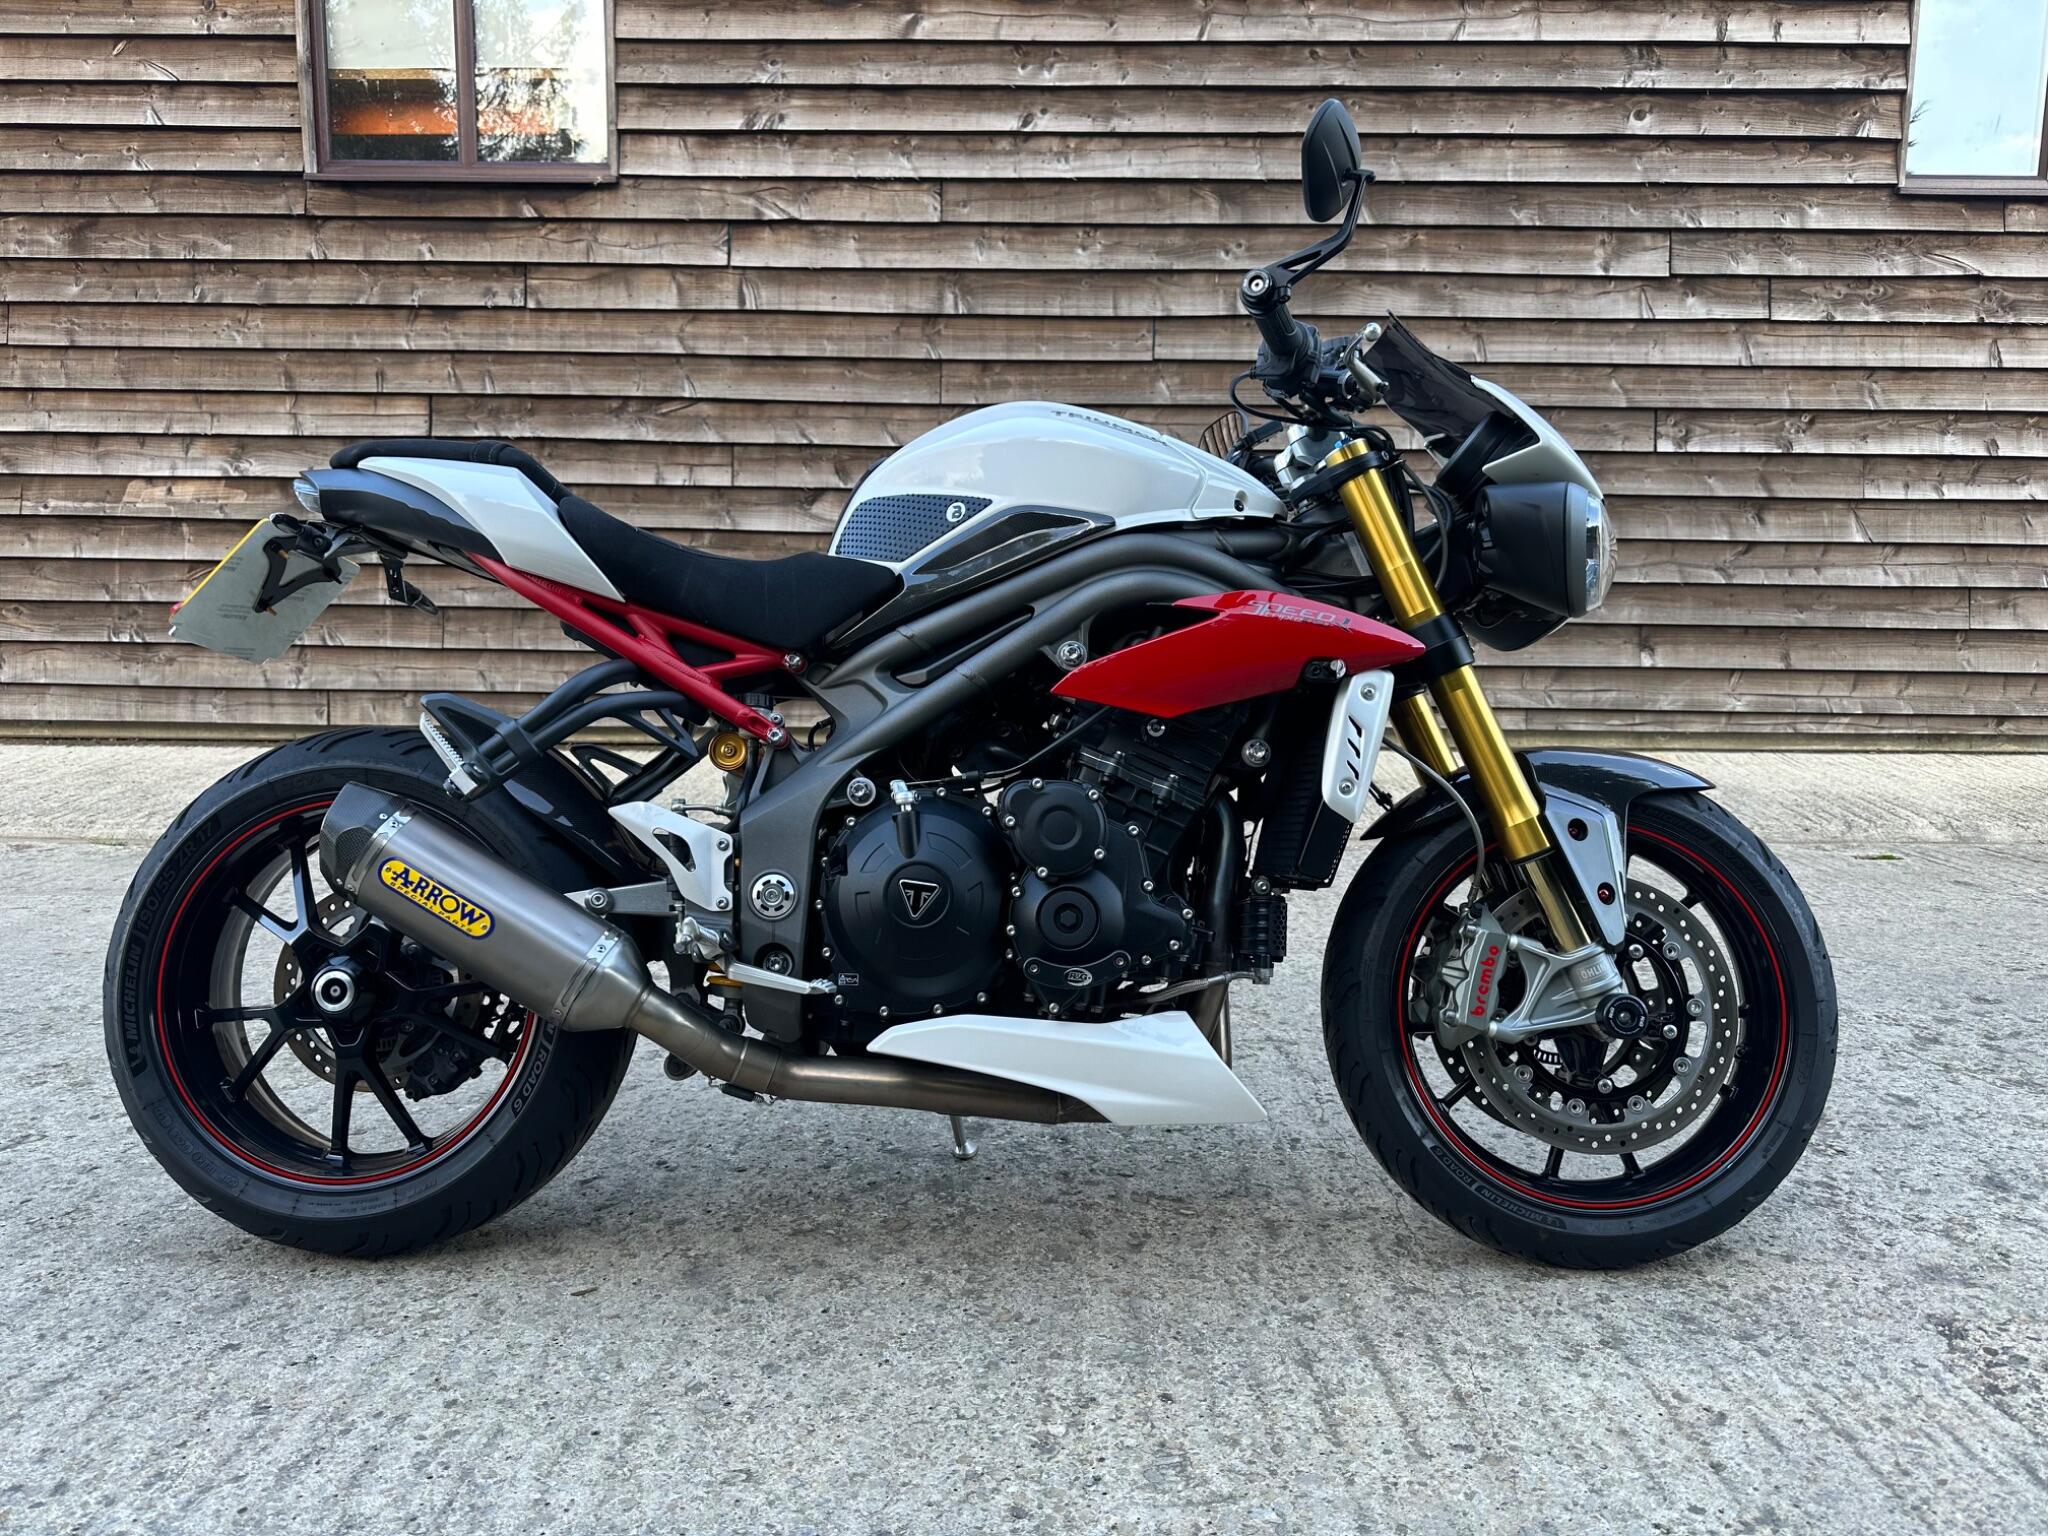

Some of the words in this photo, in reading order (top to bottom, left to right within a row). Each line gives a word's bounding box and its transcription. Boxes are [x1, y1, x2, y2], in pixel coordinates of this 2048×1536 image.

[390, 882, 435, 913] SPECIAL
[438, 911, 473, 933] PARTS
[391, 867, 486, 926] ARROW
[123, 943, 141, 1041] MICHELIN
[1470, 945, 1500, 1017] brembo
[521, 1048, 547, 1095] ROAD
[1441, 1156, 1472, 1184] ROAD
[1480, 1188, 1544, 1221] MICHELIN
